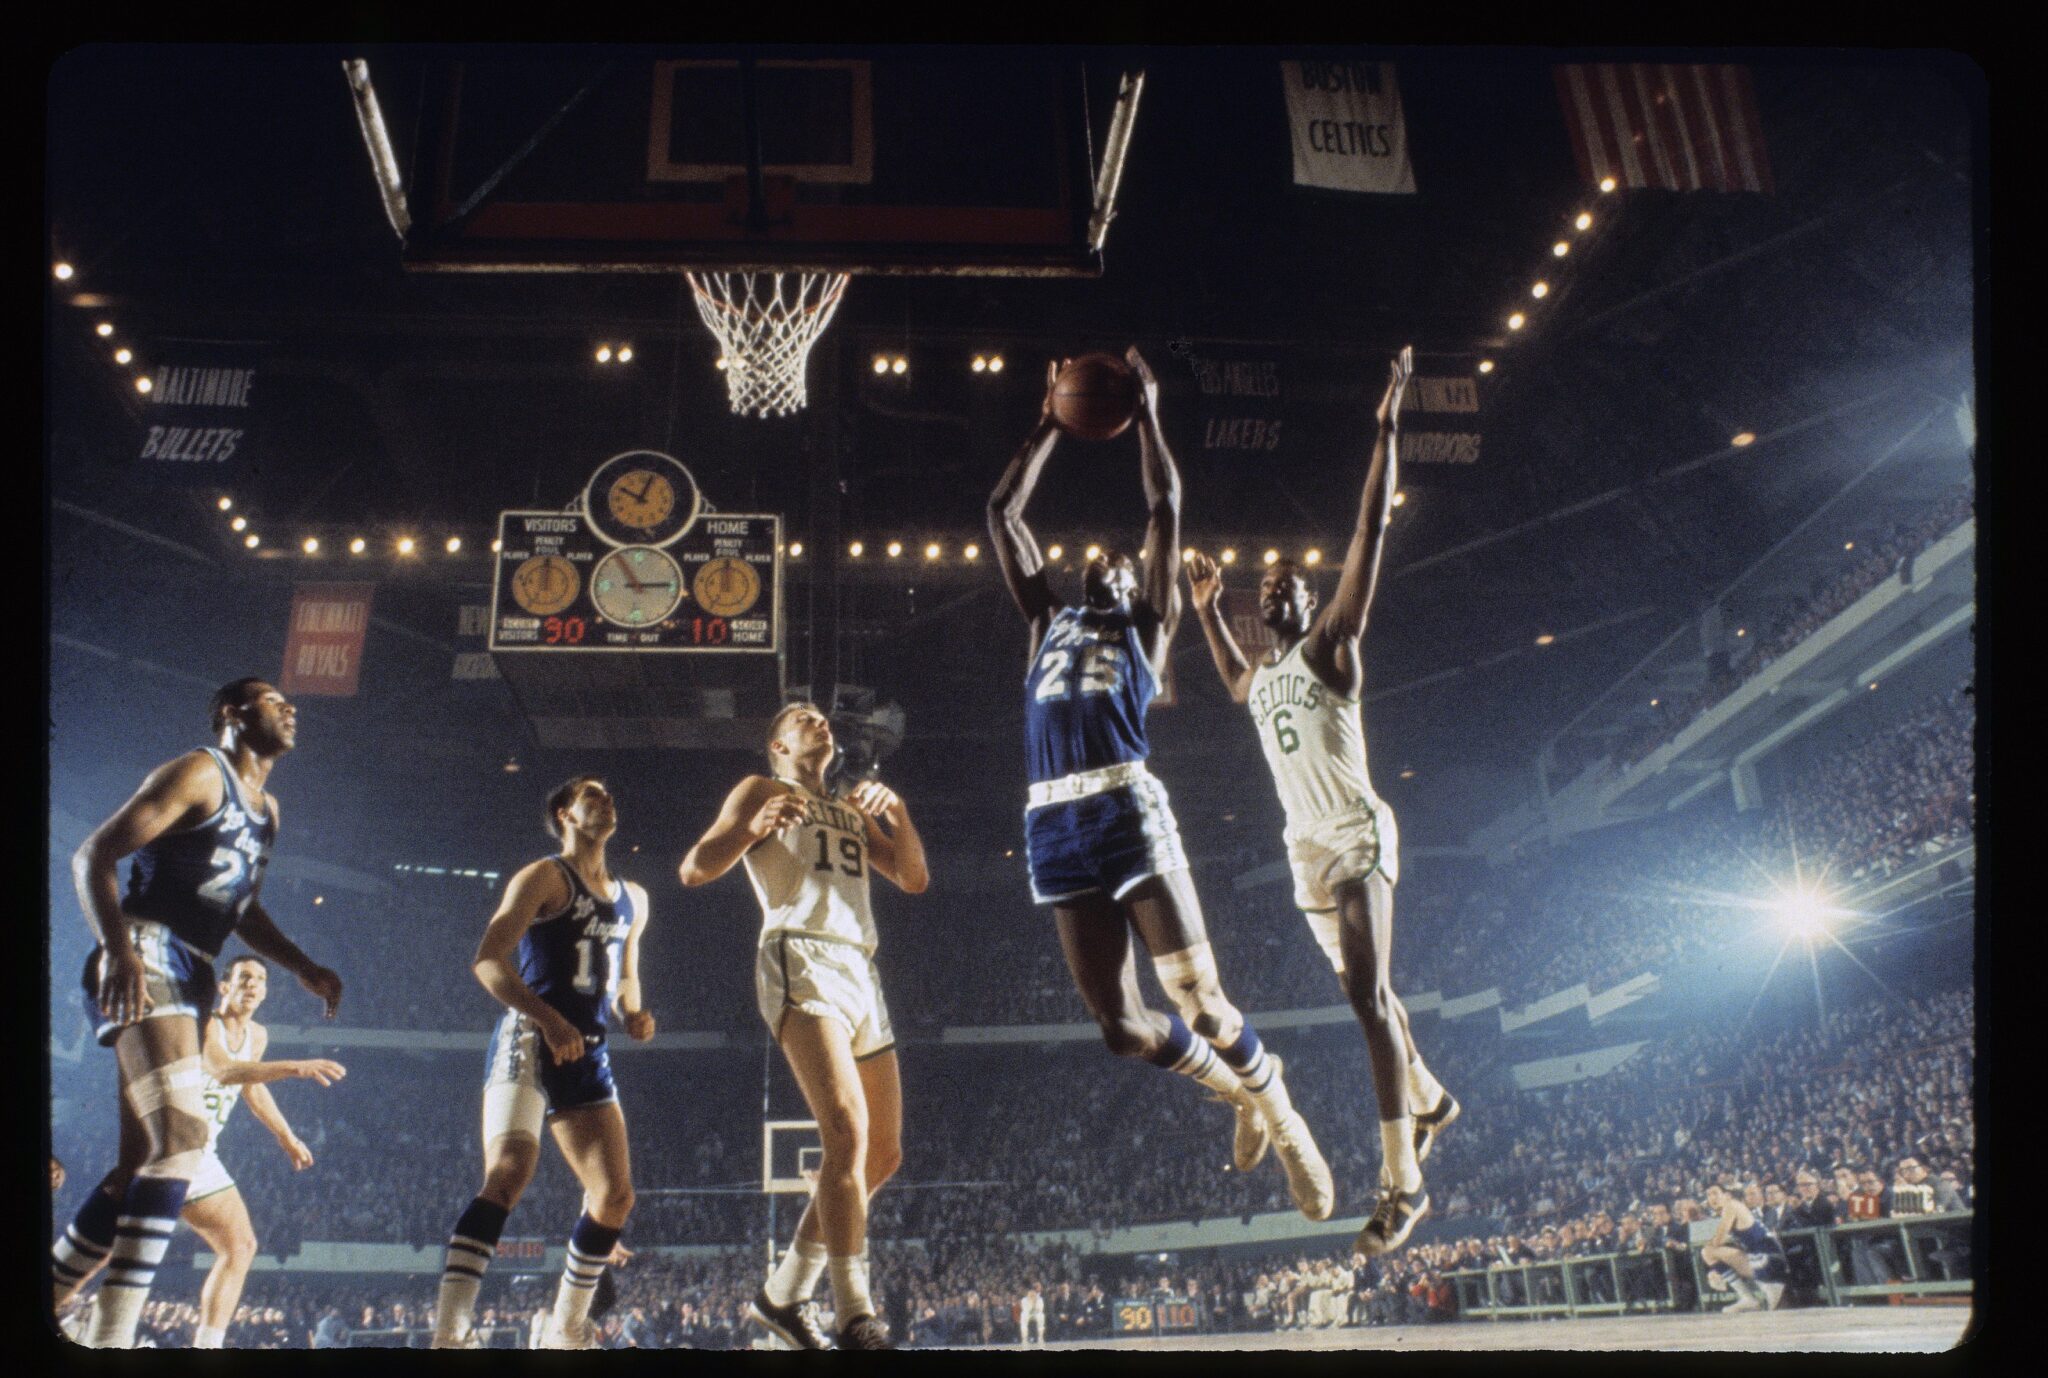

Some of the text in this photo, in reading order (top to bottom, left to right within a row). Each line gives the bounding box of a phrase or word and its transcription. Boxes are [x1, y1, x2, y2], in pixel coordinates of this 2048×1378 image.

[1309, 119, 1391, 157] CELTICS
[141, 425, 243, 462] BULLETS
[1205, 417, 1282, 449] LAKERS
[524, 518, 578, 533] VISITORS
[706, 521, 749, 535] HOME
[692, 617, 727, 645] 10
[733, 631, 766, 643] HOME
[1273, 709, 1301, 755] 6
[814, 829, 863, 878] 19
[572, 938, 620, 997] 11
